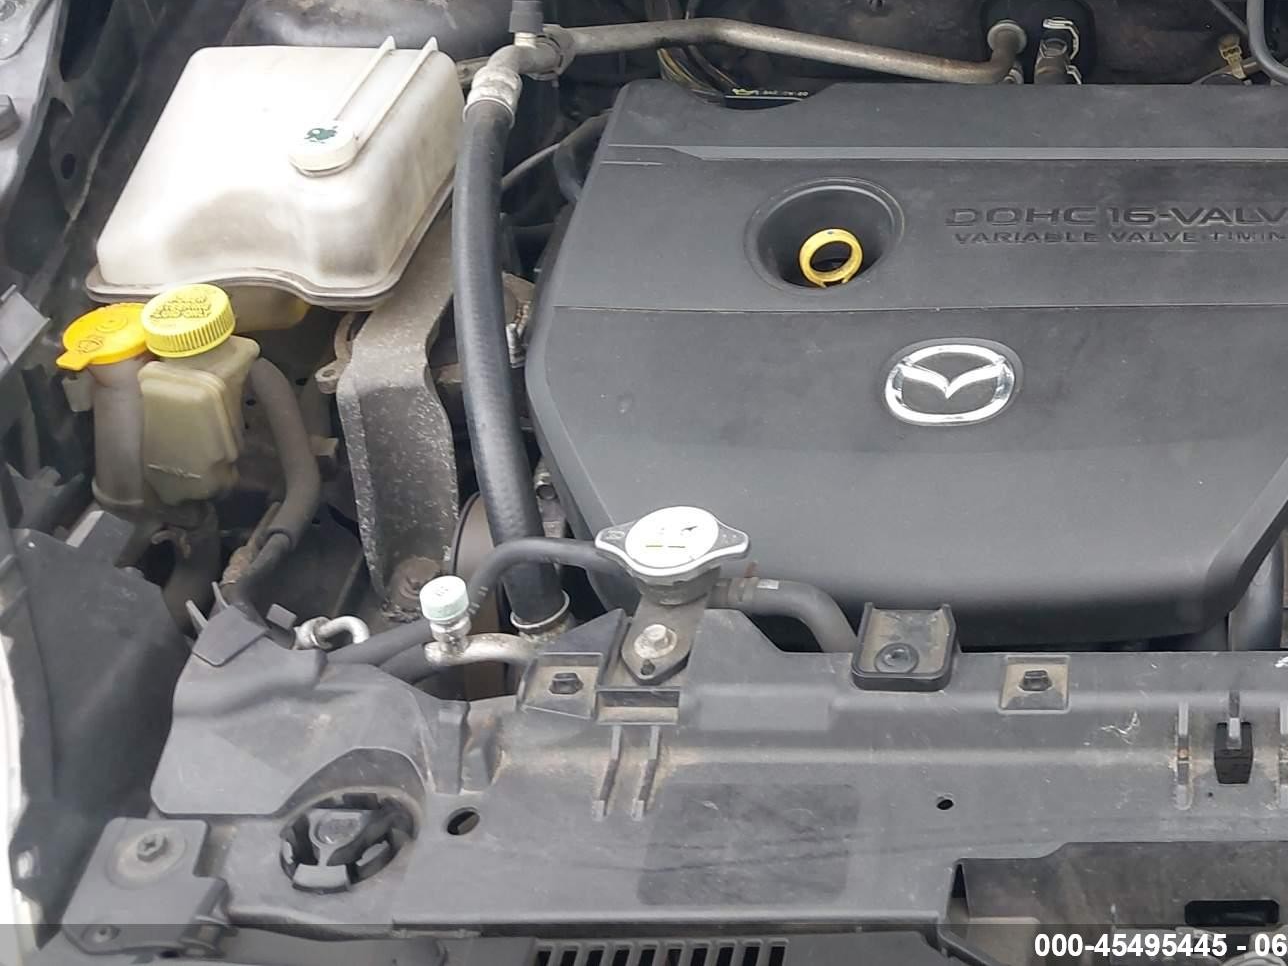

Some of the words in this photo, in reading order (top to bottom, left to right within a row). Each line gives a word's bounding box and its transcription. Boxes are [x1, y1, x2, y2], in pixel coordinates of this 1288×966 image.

[946, 206, 1096, 227] DOHC
[954, 232, 1099, 245] VARIABLE
[1110, 231, 1197, 244] VALVE
